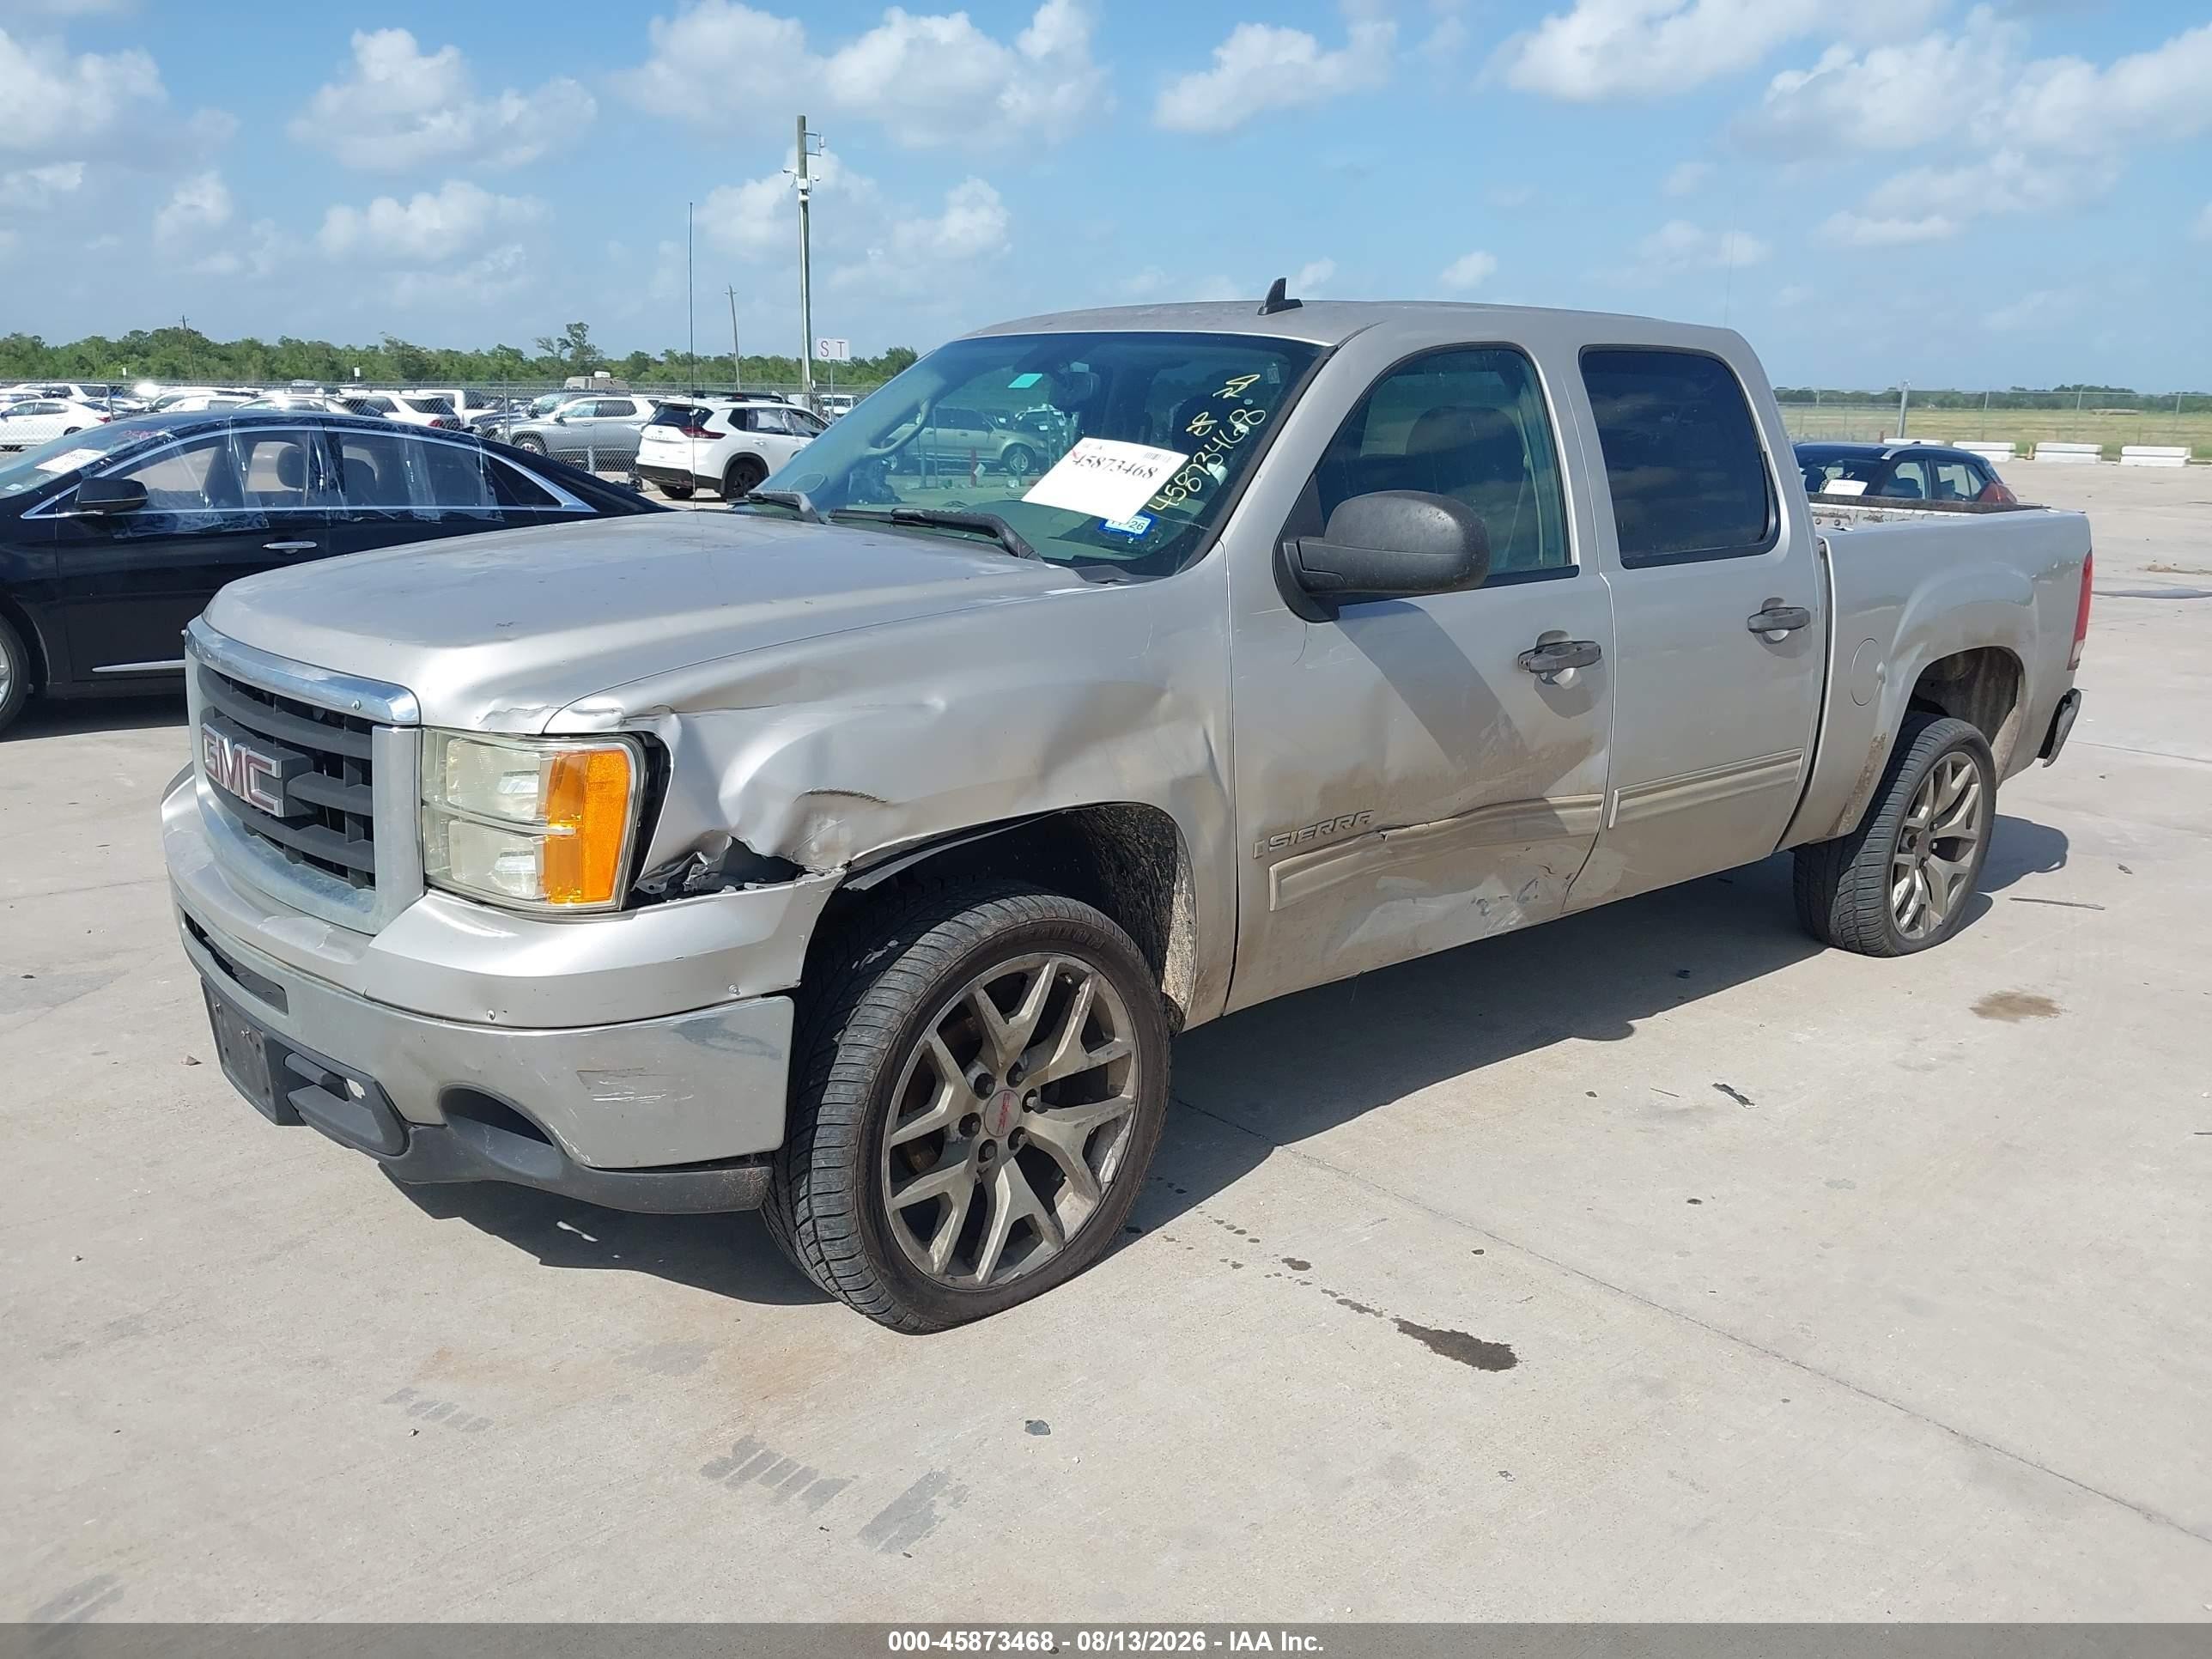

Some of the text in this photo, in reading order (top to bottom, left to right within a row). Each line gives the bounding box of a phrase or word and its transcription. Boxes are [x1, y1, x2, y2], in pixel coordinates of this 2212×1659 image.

[820, 340, 846, 358] S T
[1073, 453, 1159, 479] 45873468
[1147, 409, 1267, 511] 45873468
[201, 722, 285, 818] GMC
[1268, 809, 1375, 852] SIERRA
